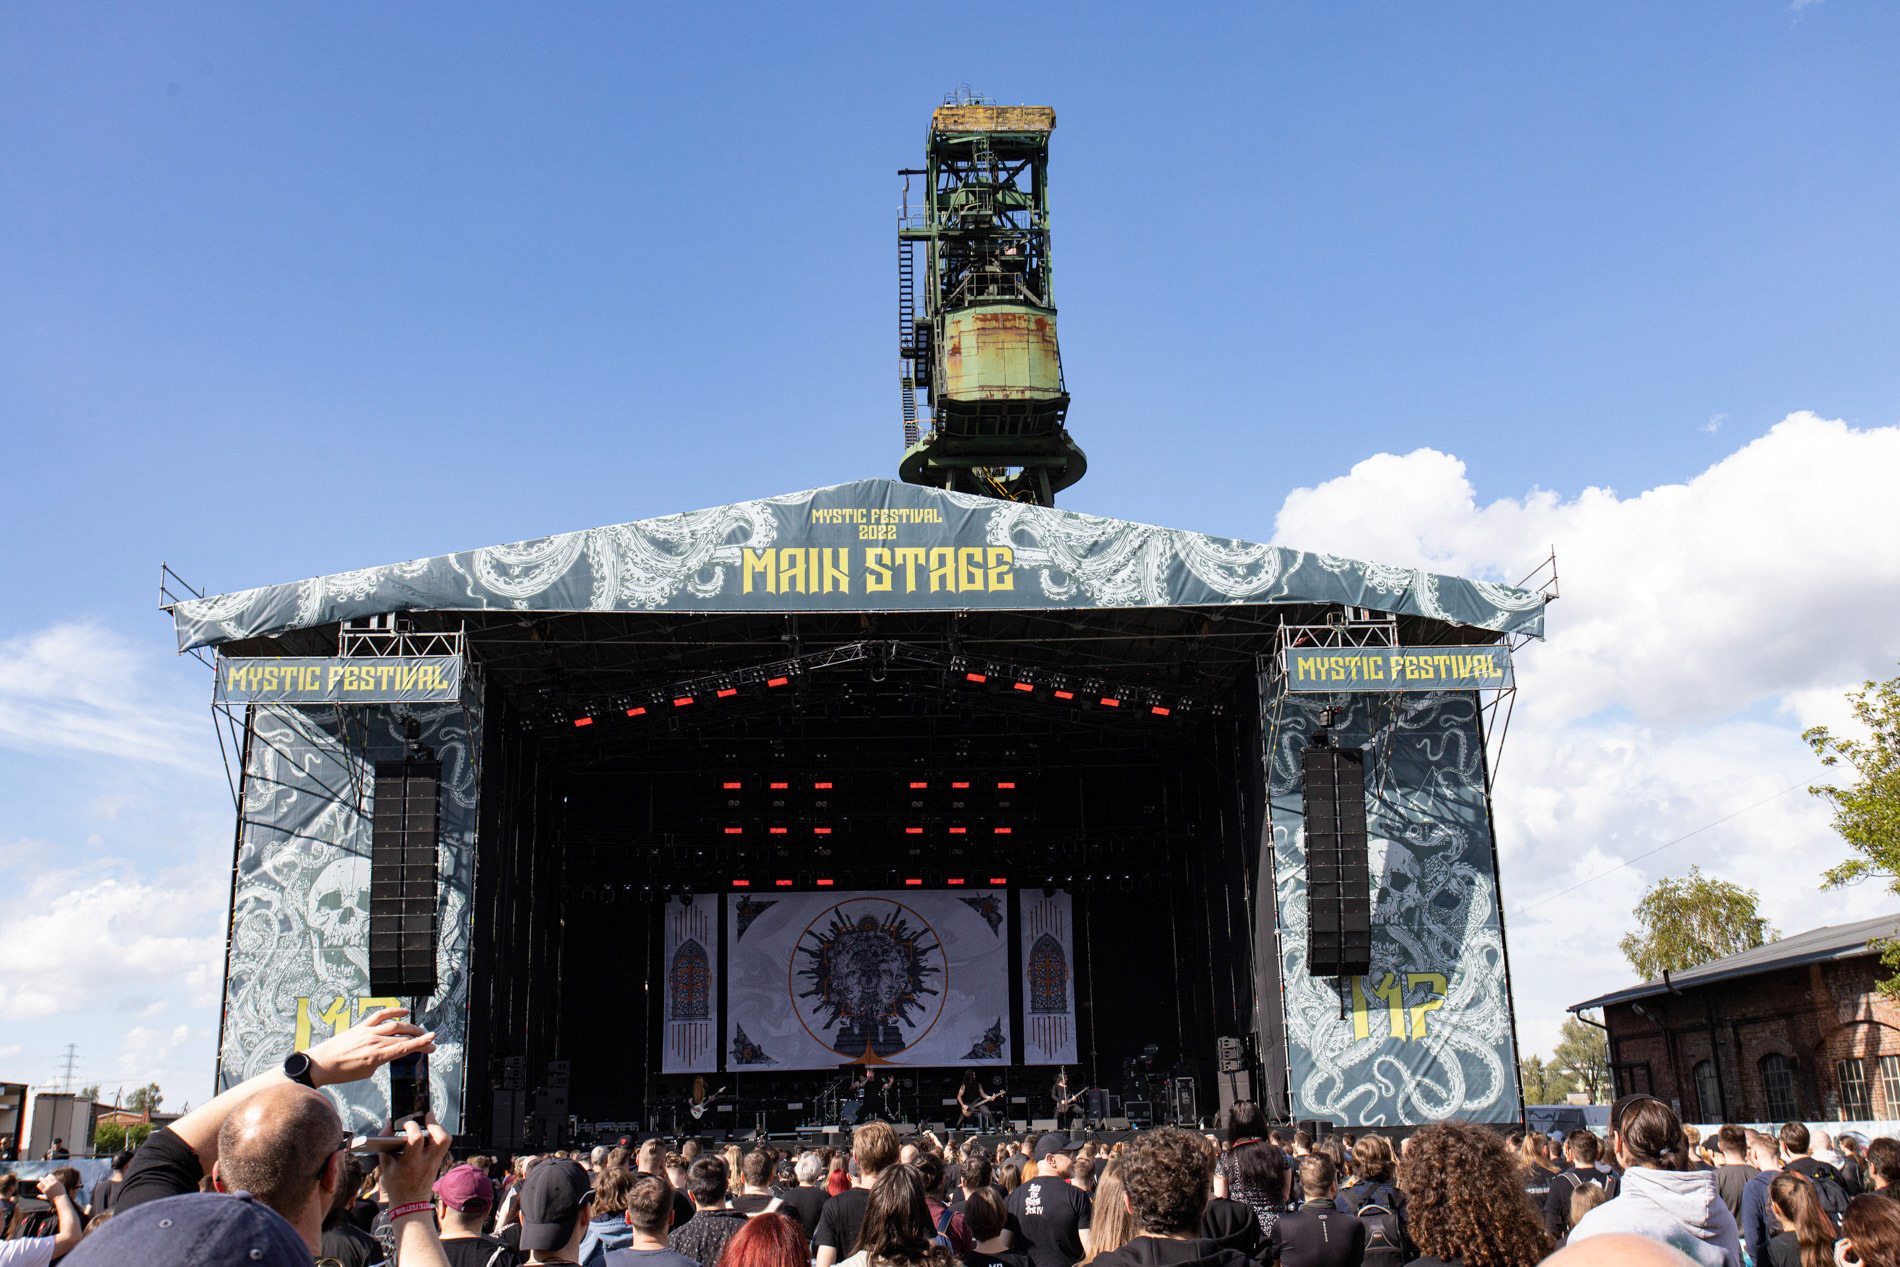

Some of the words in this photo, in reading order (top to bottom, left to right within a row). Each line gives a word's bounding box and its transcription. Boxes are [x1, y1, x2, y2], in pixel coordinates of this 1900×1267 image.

[812, 508, 867, 524] MYSTIC
[871, 508, 943, 524] FESTIVAL
[859, 525, 897, 540] 2022
[743, 548, 850, 595] MAIN
[865, 547, 1014, 595] STAGE
[227, 666, 321, 692] MYSTIC
[327, 666, 449, 692] FESTIVAL
[1298, 656, 1384, 681] MYSTIC
[1390, 655, 1503, 681] FESTIVAL
